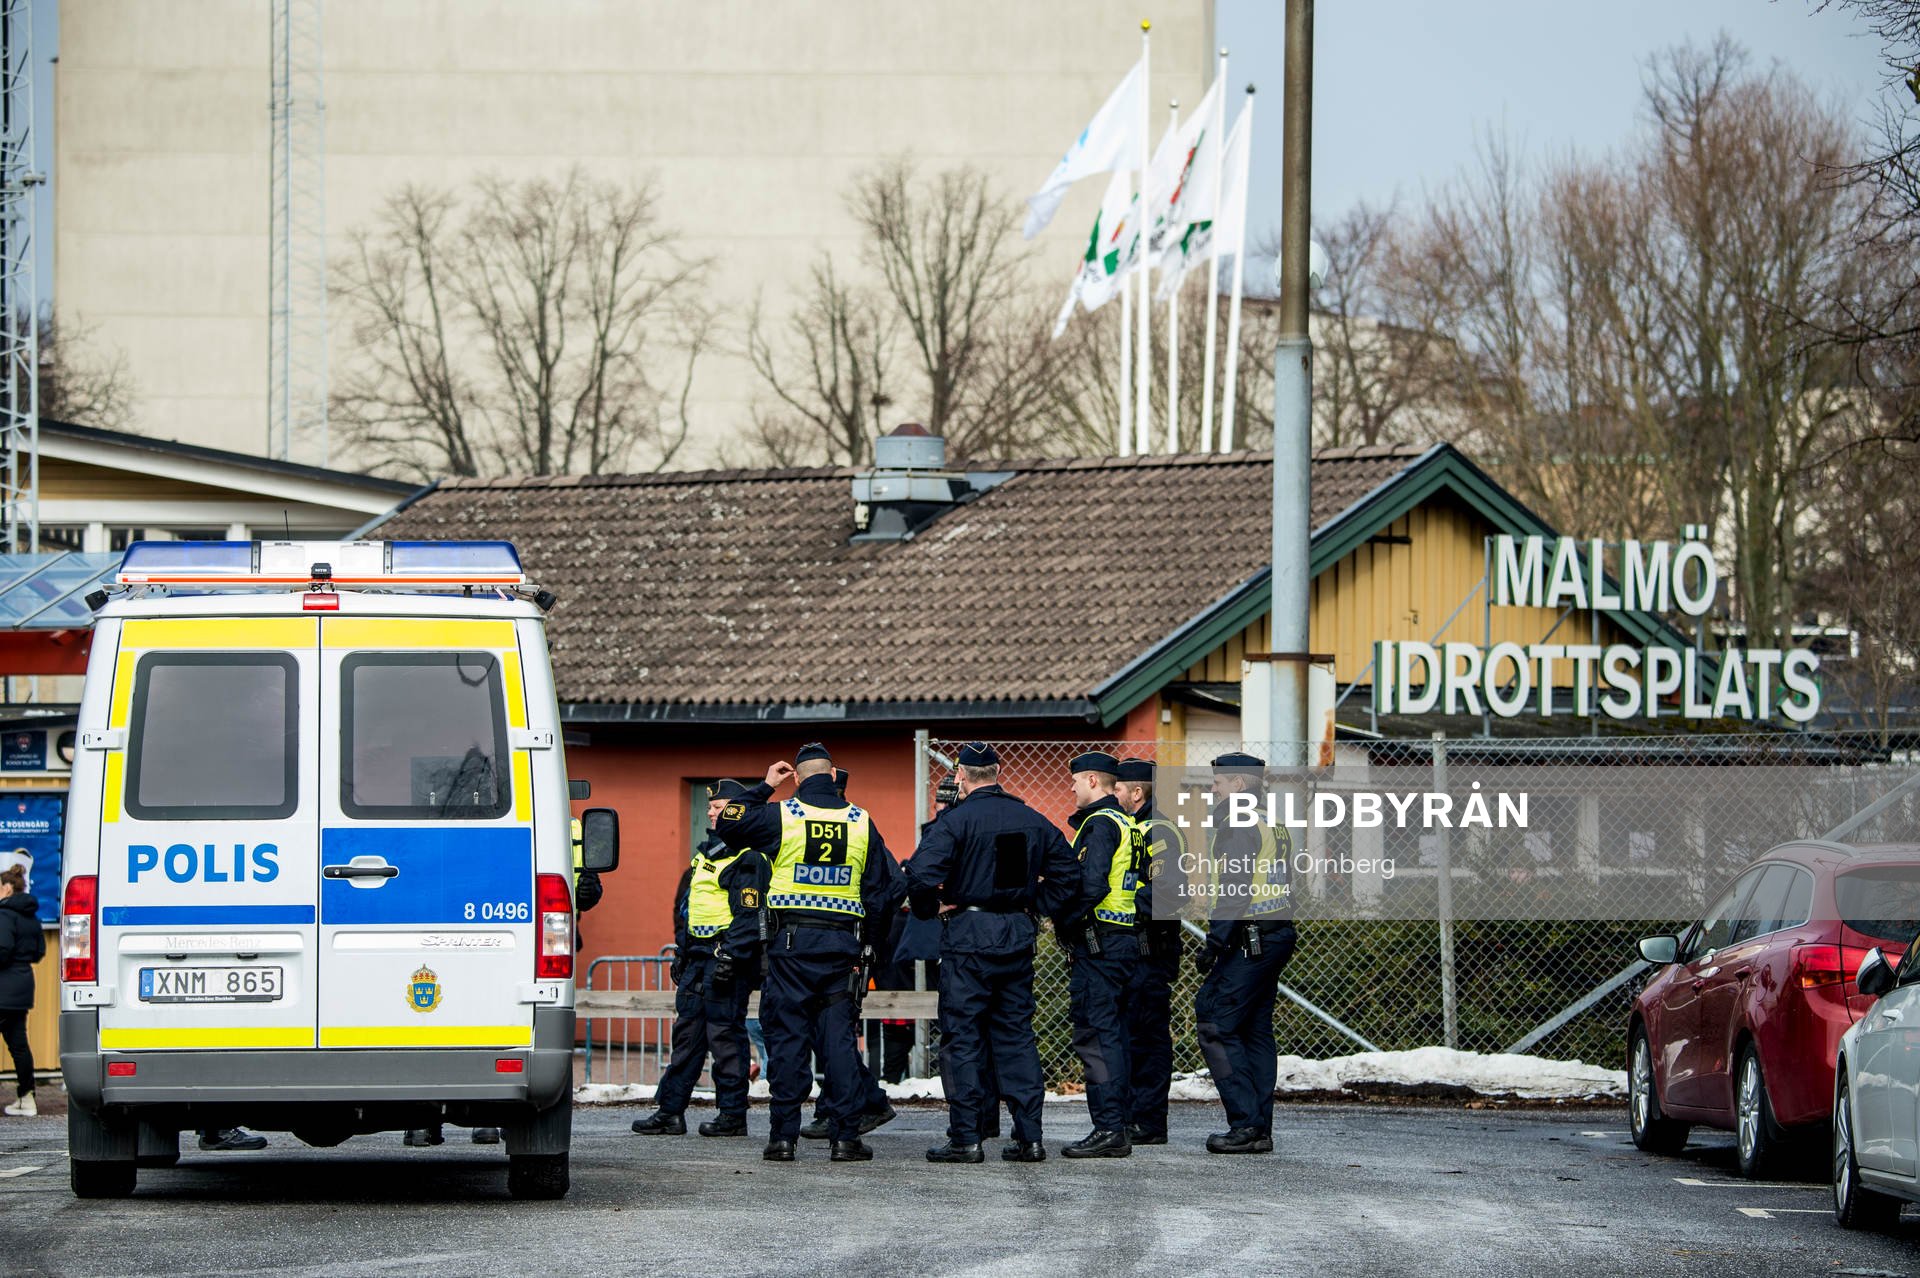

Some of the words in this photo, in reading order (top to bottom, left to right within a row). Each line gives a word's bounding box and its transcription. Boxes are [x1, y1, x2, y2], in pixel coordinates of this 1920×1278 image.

[1494, 524, 1717, 616] MALMÖ
[1376, 640, 1822, 722] IDROTTSPLATS
[811, 823, 842, 840] D51
[1132, 831, 1144, 847] D51
[818, 843, 832, 862] 2
[127, 844, 280, 884] POLIS
[795, 866, 851, 885] POLIS
[464, 902, 476, 920] 8
[481, 902, 529, 920] 0496
[158, 972, 206, 994] XNM
[226, 971, 275, 993] 865
